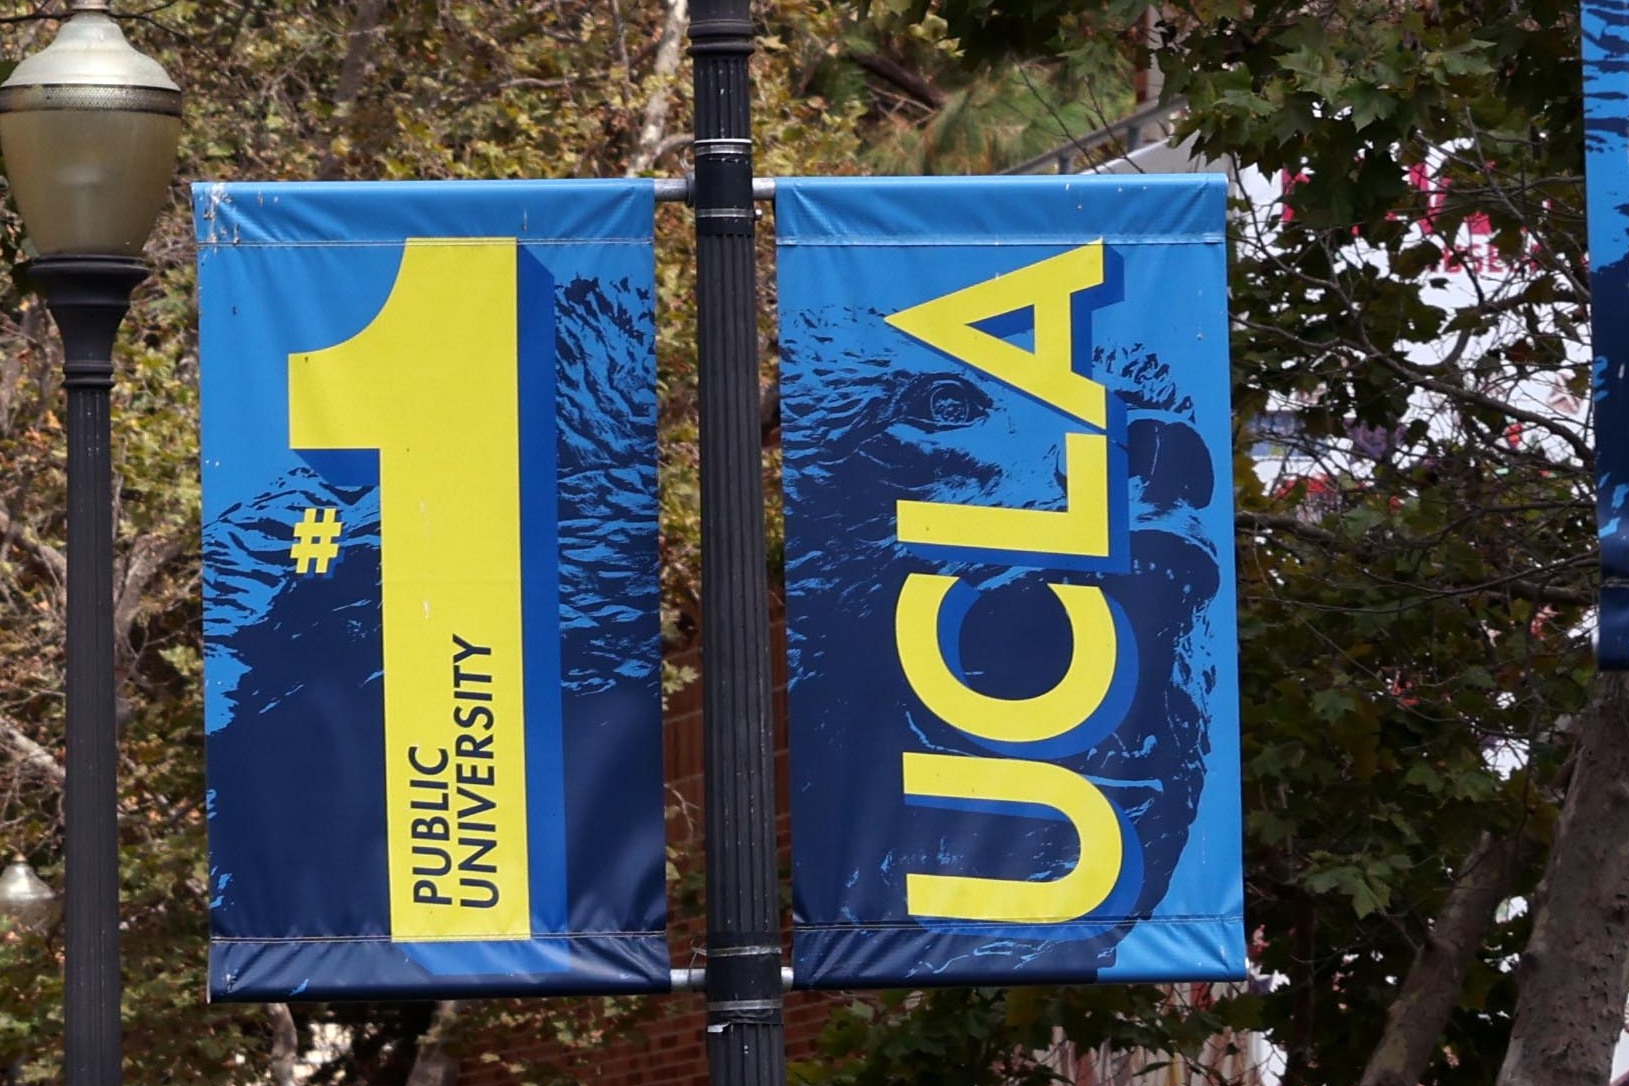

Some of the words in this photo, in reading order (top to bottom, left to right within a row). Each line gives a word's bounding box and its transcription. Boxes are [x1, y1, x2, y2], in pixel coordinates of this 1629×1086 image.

[886, 241, 1116, 923] UCLA
[408, 745, 453, 905] PUBLIC
[452, 632, 500, 909] UNIVERSITY
